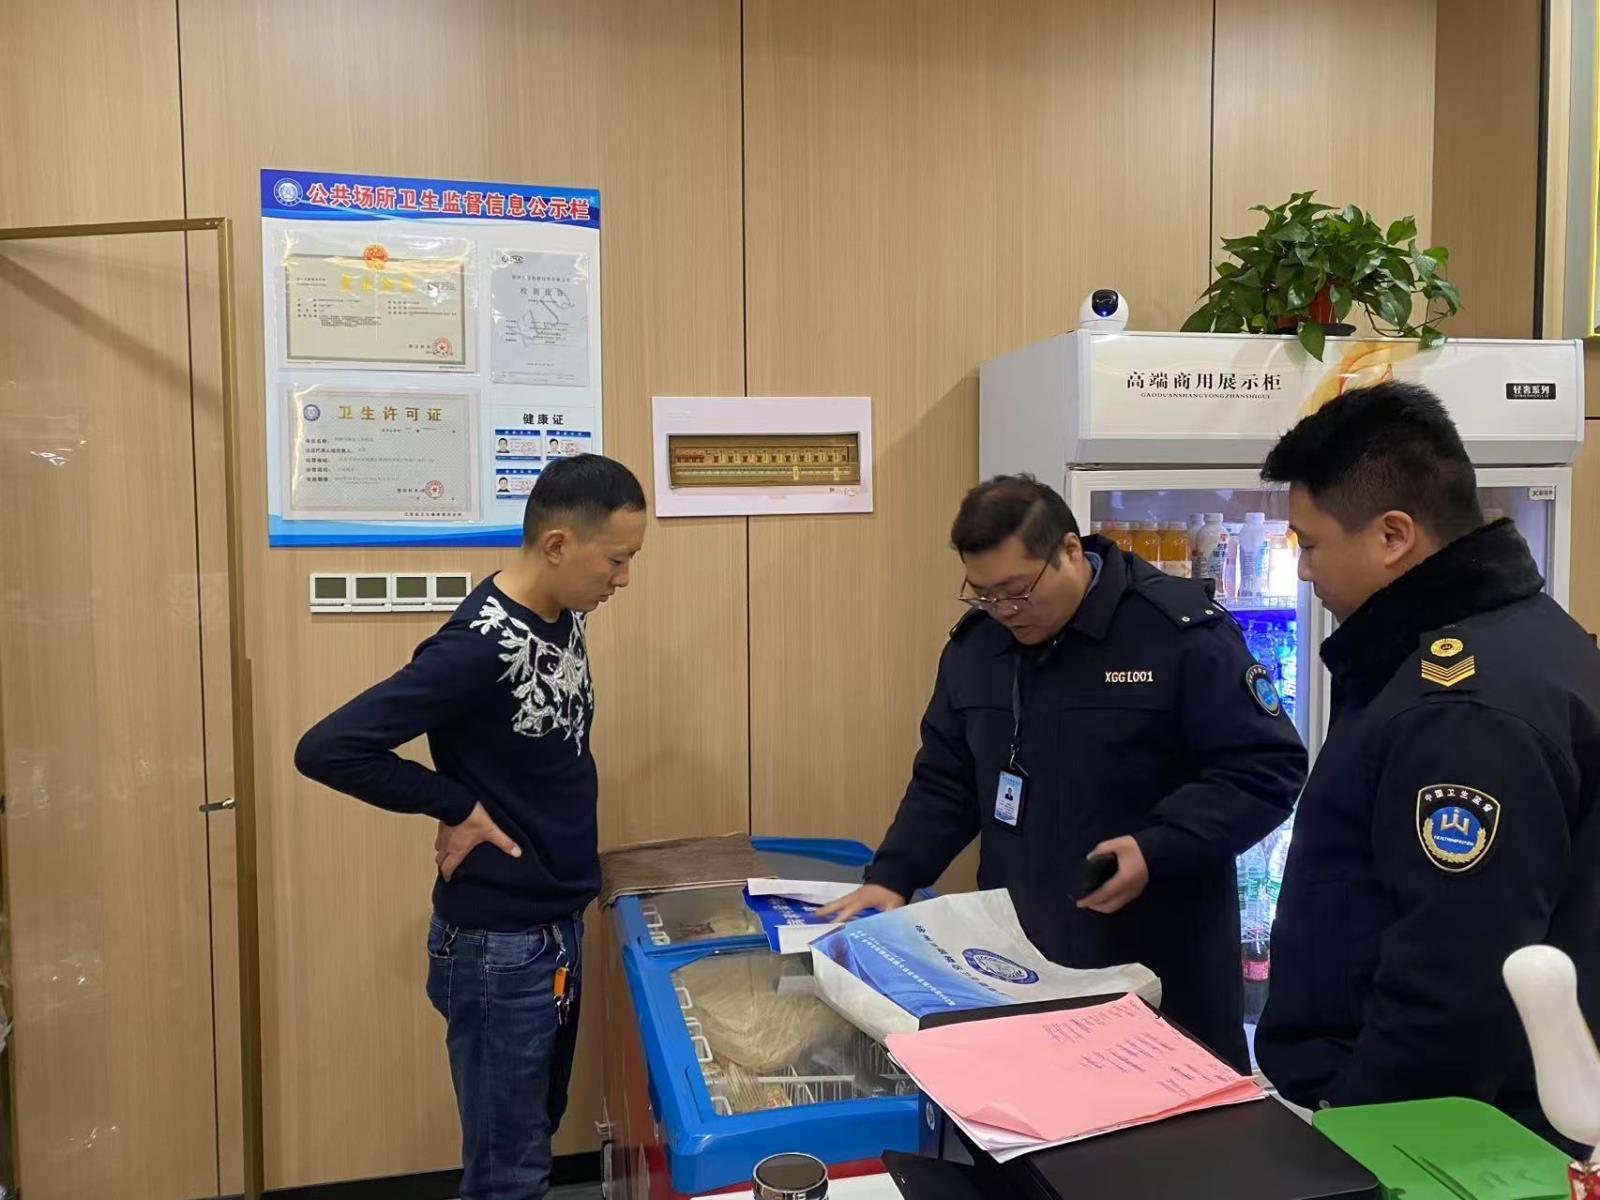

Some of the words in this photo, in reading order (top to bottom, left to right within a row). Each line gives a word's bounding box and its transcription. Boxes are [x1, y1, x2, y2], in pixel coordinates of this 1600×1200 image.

[306, 182, 590, 219] 公共场所卫生监督信息公示栏
[1127, 371, 1282, 391] 高端商用展示柜
[338, 405, 443, 421] 卫生许可证
[522, 413, 565, 425] 健康证
[1105, 671, 1154, 683] XGGL001
